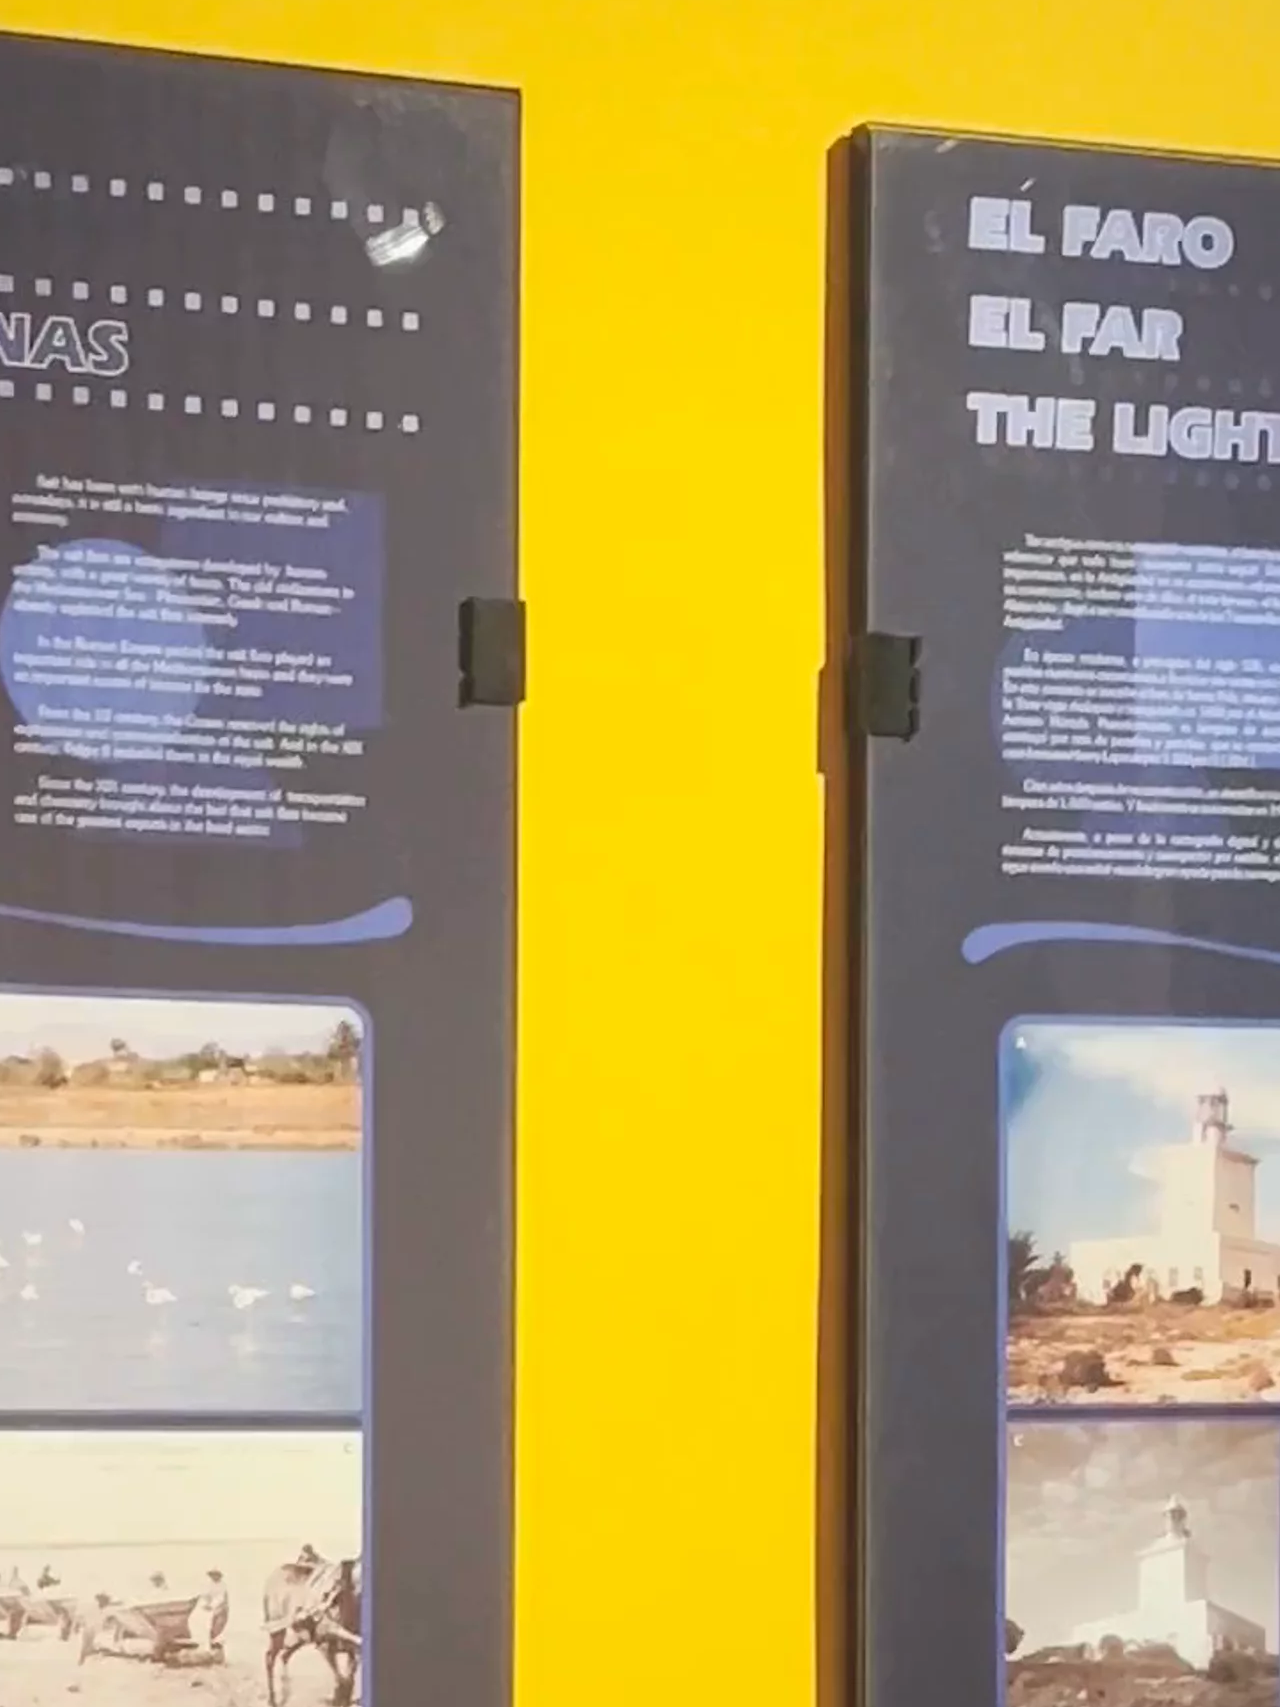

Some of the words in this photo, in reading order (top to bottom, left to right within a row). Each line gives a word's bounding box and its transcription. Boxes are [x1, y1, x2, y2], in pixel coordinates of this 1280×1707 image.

[968, 195, 1046, 254] EL
[1061, 204, 1235, 270] FARO
[968, 294, 1046, 351] EL
[1060, 301, 1184, 361] FAR
[966, 392, 1096, 451] THE
